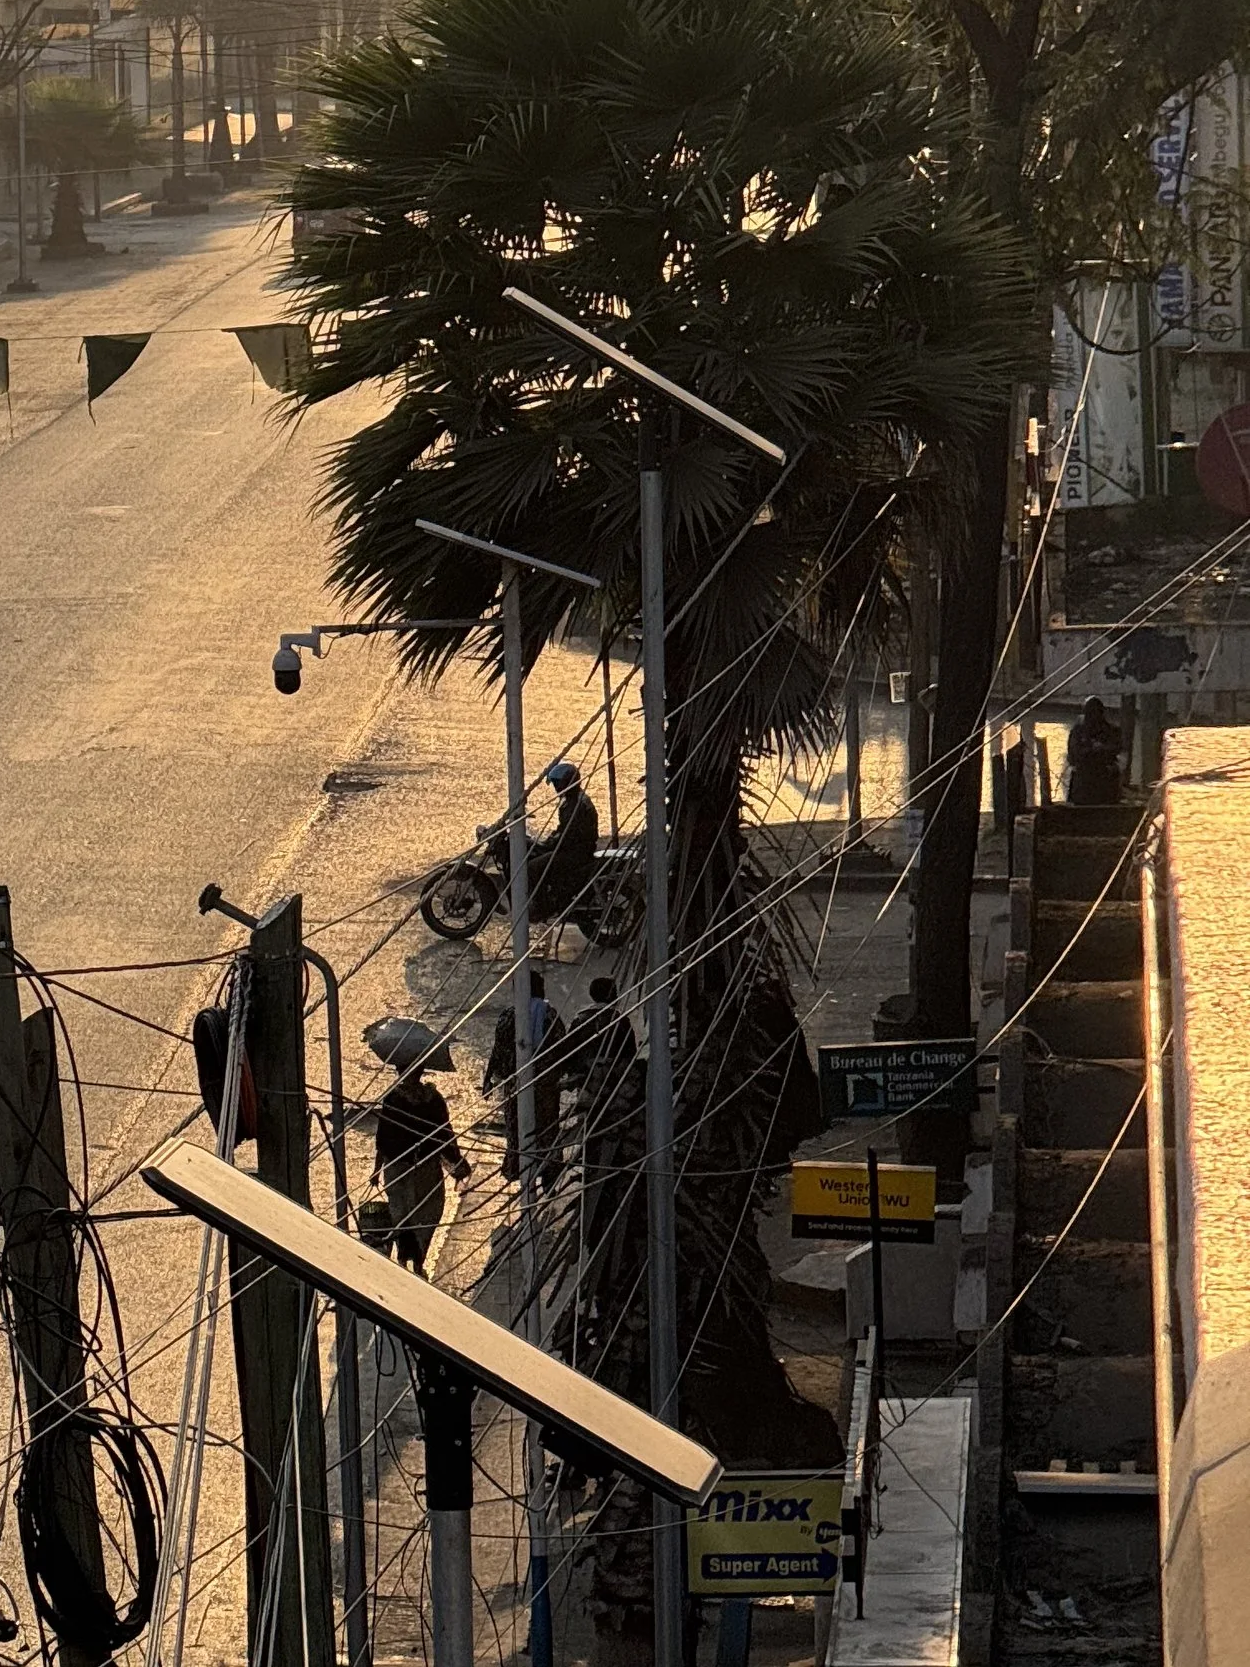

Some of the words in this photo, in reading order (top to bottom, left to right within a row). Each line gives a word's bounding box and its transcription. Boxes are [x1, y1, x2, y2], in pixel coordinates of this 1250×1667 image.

[830, 1055, 883, 1070] Bureau
[887, 1052, 906, 1066] de
[909, 1050, 967, 1068] Change
[887, 1070, 935, 1082] Tanzania
[887, 1090, 916, 1103] Bank
[819, 1178, 871, 1193] Wester
[838, 1193, 871, 1206] Unio
[709, 1557, 762, 1577] Super
[765, 1556, 819, 1577] Agent
